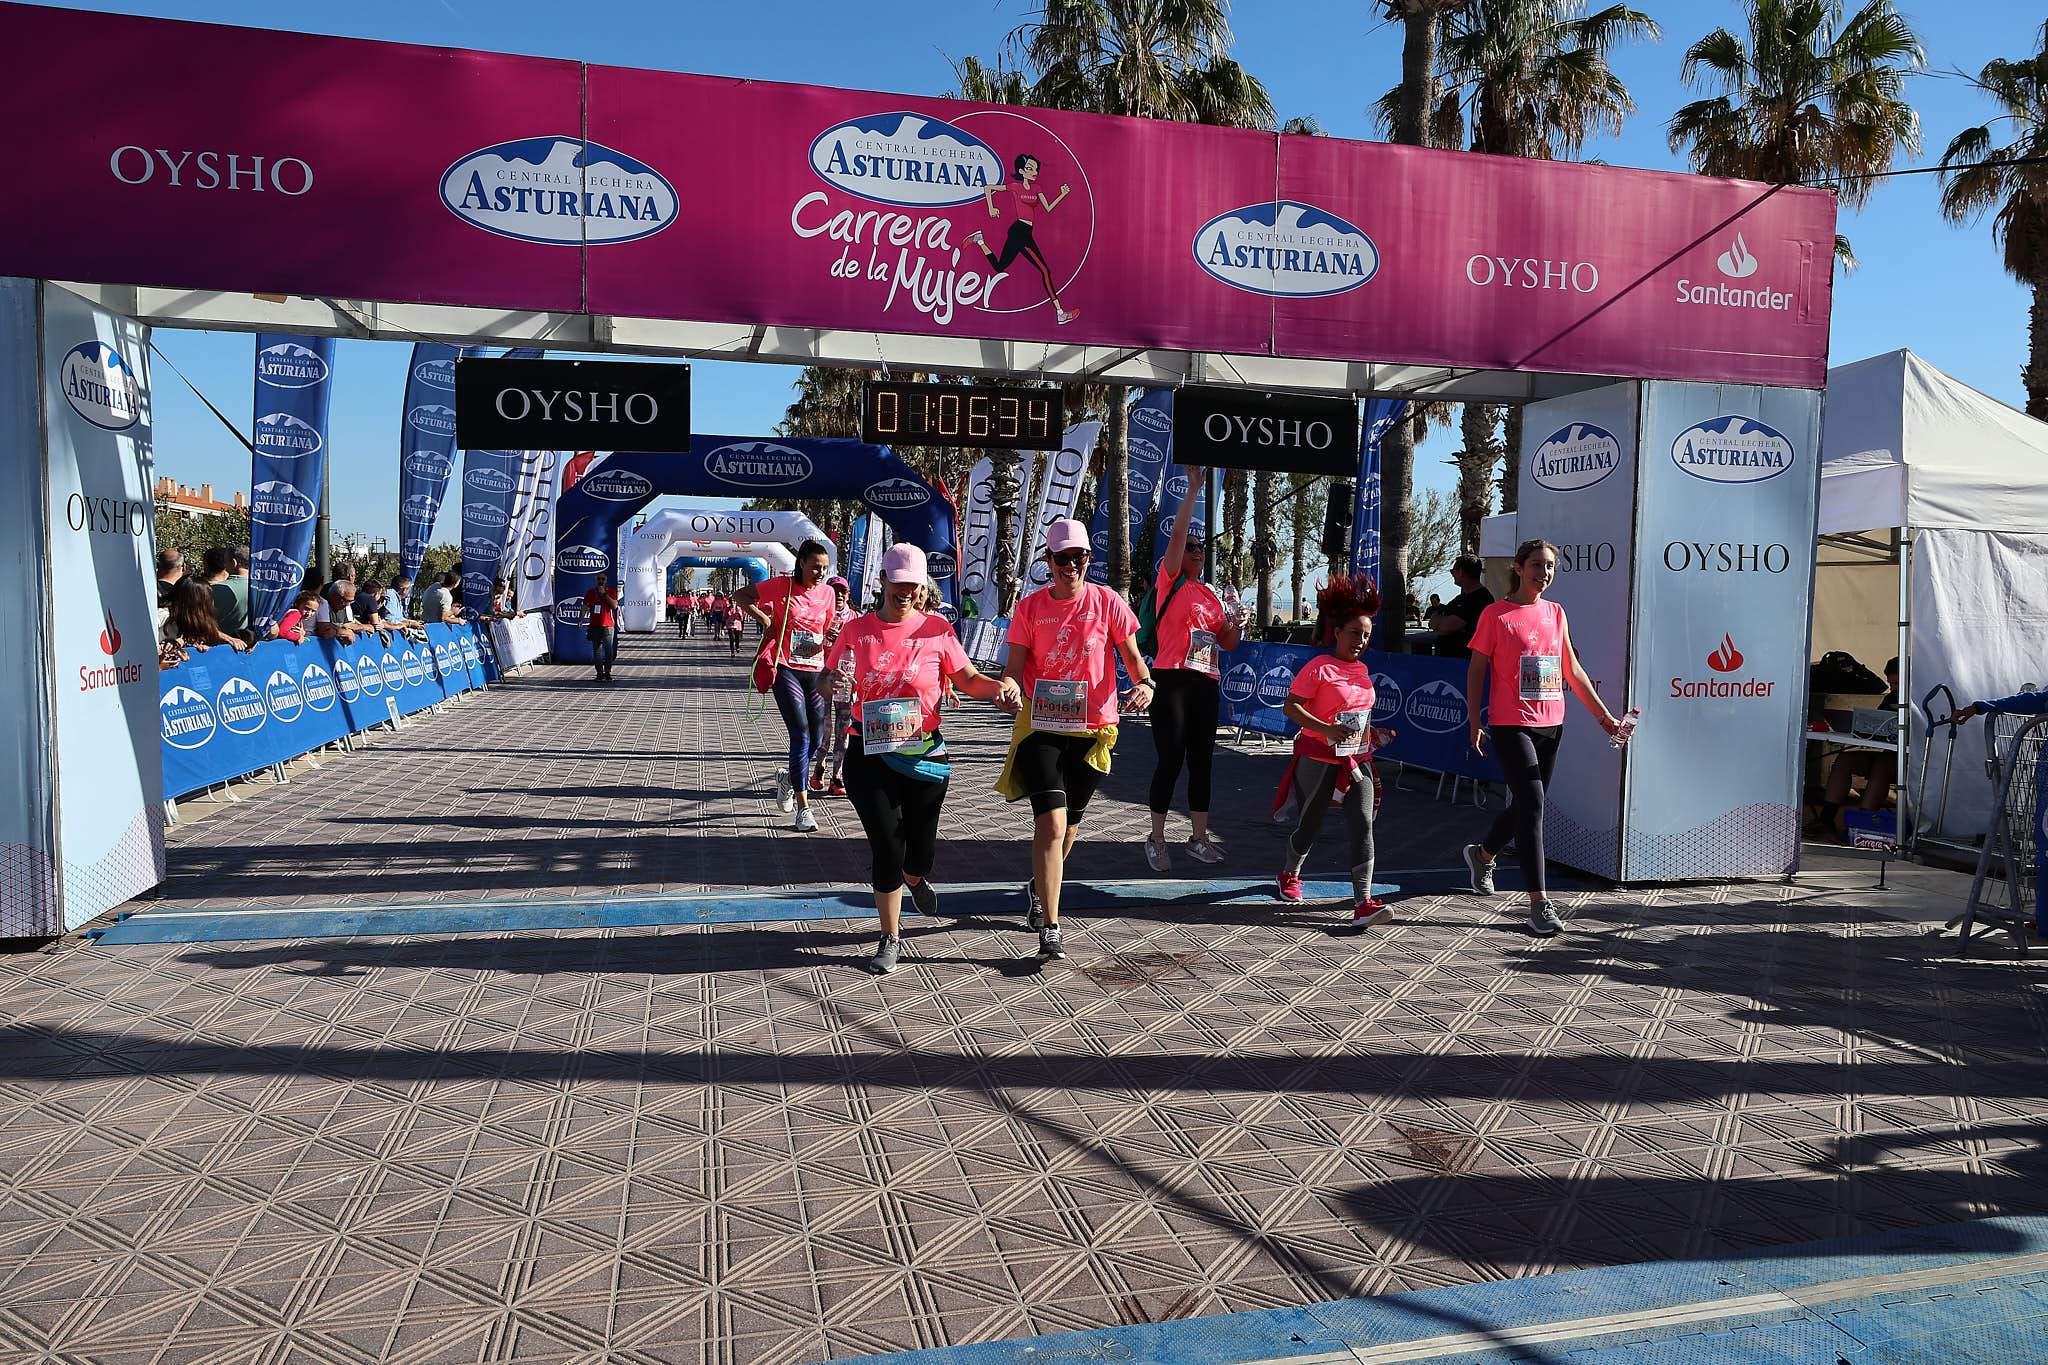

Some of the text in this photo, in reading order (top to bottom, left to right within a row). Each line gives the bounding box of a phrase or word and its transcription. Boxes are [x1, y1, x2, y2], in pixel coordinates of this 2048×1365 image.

[825, 139, 988, 188] ASTURIANA
[856, 140, 984, 160] CENTRAL LECHERA
[110, 145, 314, 195] OYSHO
[497, 169, 571, 184] CENTRAL
[459, 169, 661, 221] ASTURIANA
[791, 191, 955, 249] Carrera
[1207, 230, 1365, 276] ASTURIANA
[1237, 231, 1360, 248] CENTRAL LECHERA
[830, 245, 1009, 325] de la Mujer
[1466, 254, 1600, 293] OYSHO
[1676, 279, 1793, 311] Santander
[68, 363, 137, 415] ASTURIANA
[419, 366, 456, 385] ASTURI
[496, 388, 658, 425] OYSHO
[878, 391, 1048, 437] 01:06:34
[1204, 413, 1333, 449] OYSHO
[1700, 438, 1781, 448] CENTRAL LECHERA
[713, 454, 804, 477] ASTURIANA
[1128, 445, 1159, 461] STURIANA
[1537, 451, 1613, 478] ASTURIANA
[1680, 439, 1784, 467] ASTURIANA
[468, 472, 511, 490] ASTURIANA
[586, 480, 647, 494] ASTURIANA
[870, 488, 927, 501] ASTURIANA
[66, 492, 145, 536] OYSHO
[691, 515, 775, 534] OYSHO
[558, 555, 606, 568] ASTURIANA
[1554, 542, 1615, 572] SHO
[1664, 541, 1789, 573] OYSHO
[80, 661, 143, 692] Santander
[1259, 680, 1291, 697] ASTURIAN
[1671, 677, 1775, 698] Santander
[222, 701, 265, 724] ASTURIANA
[1408, 696, 1462, 723] ASTURIANA
[163, 712, 214, 738] ASTURIANA
